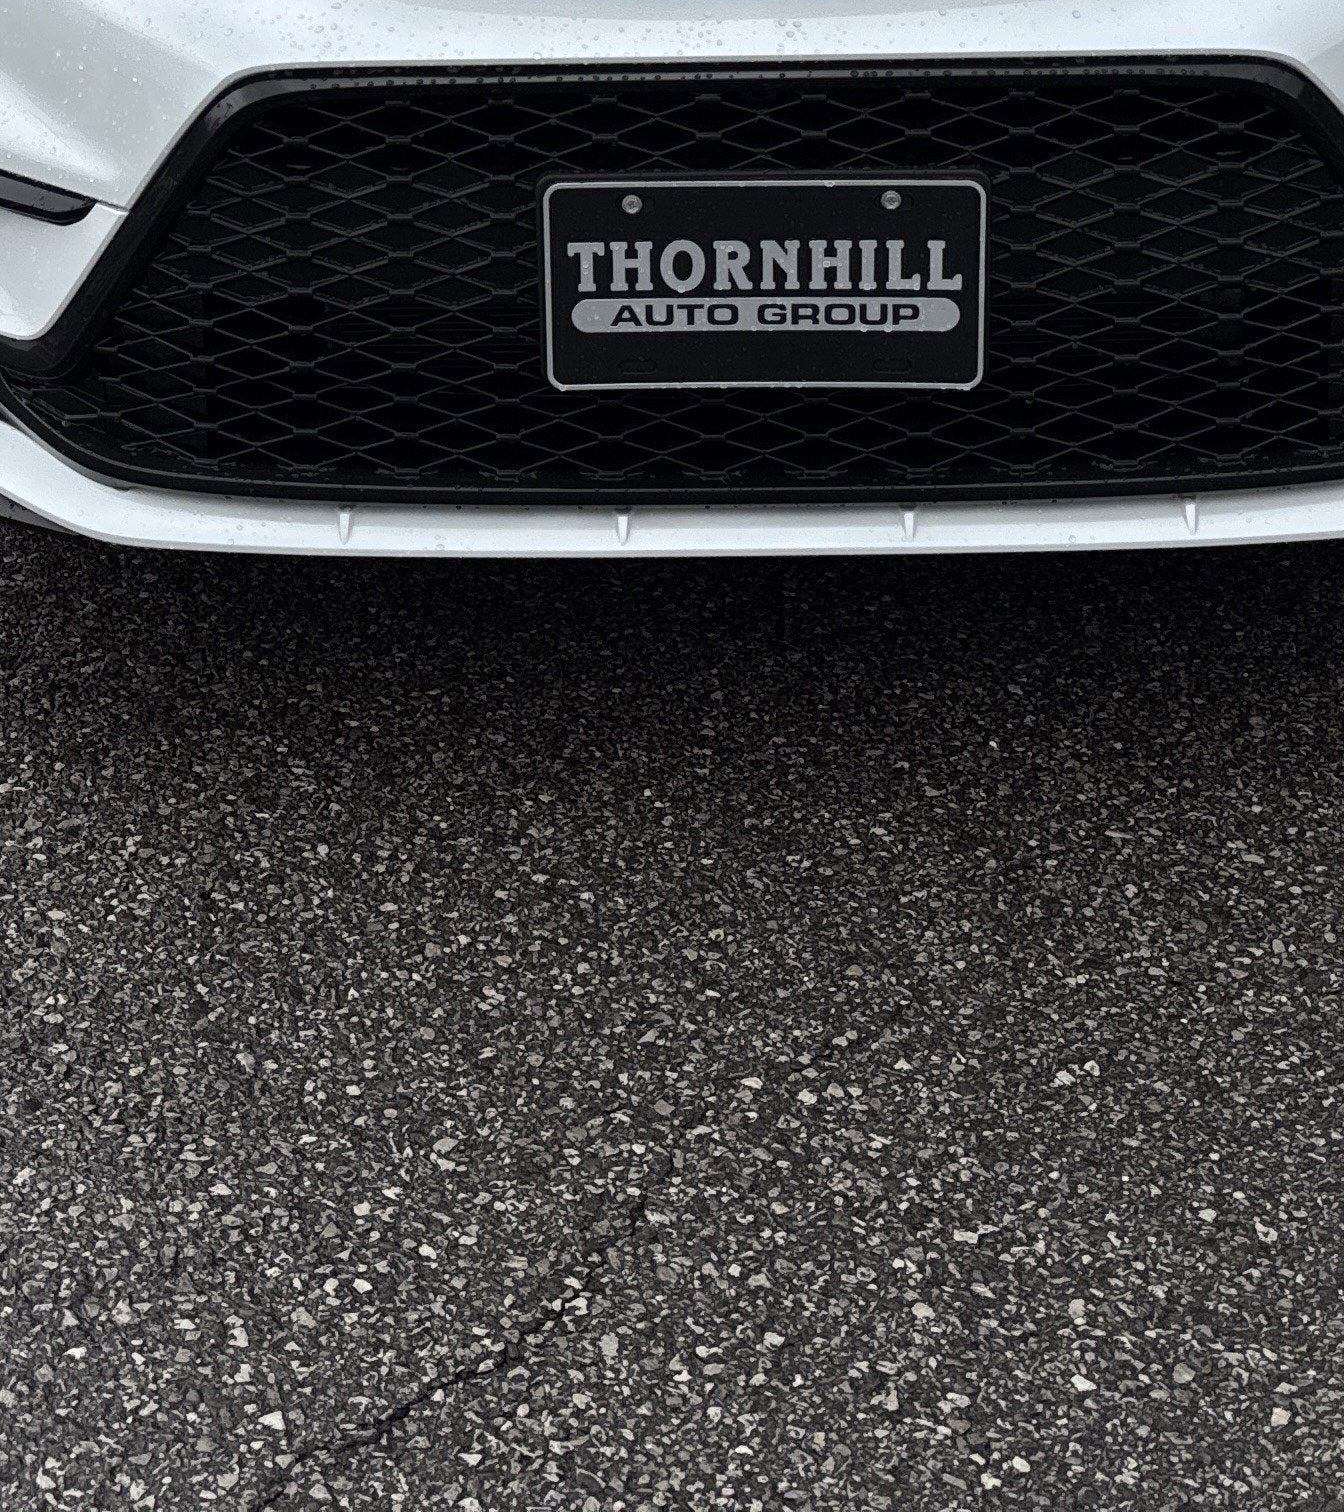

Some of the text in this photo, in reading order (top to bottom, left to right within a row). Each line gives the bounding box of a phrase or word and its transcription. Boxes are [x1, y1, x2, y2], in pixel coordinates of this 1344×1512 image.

[567, 239, 963, 293] THORNHILL
[610, 303, 920, 327] AUTO GROUP
